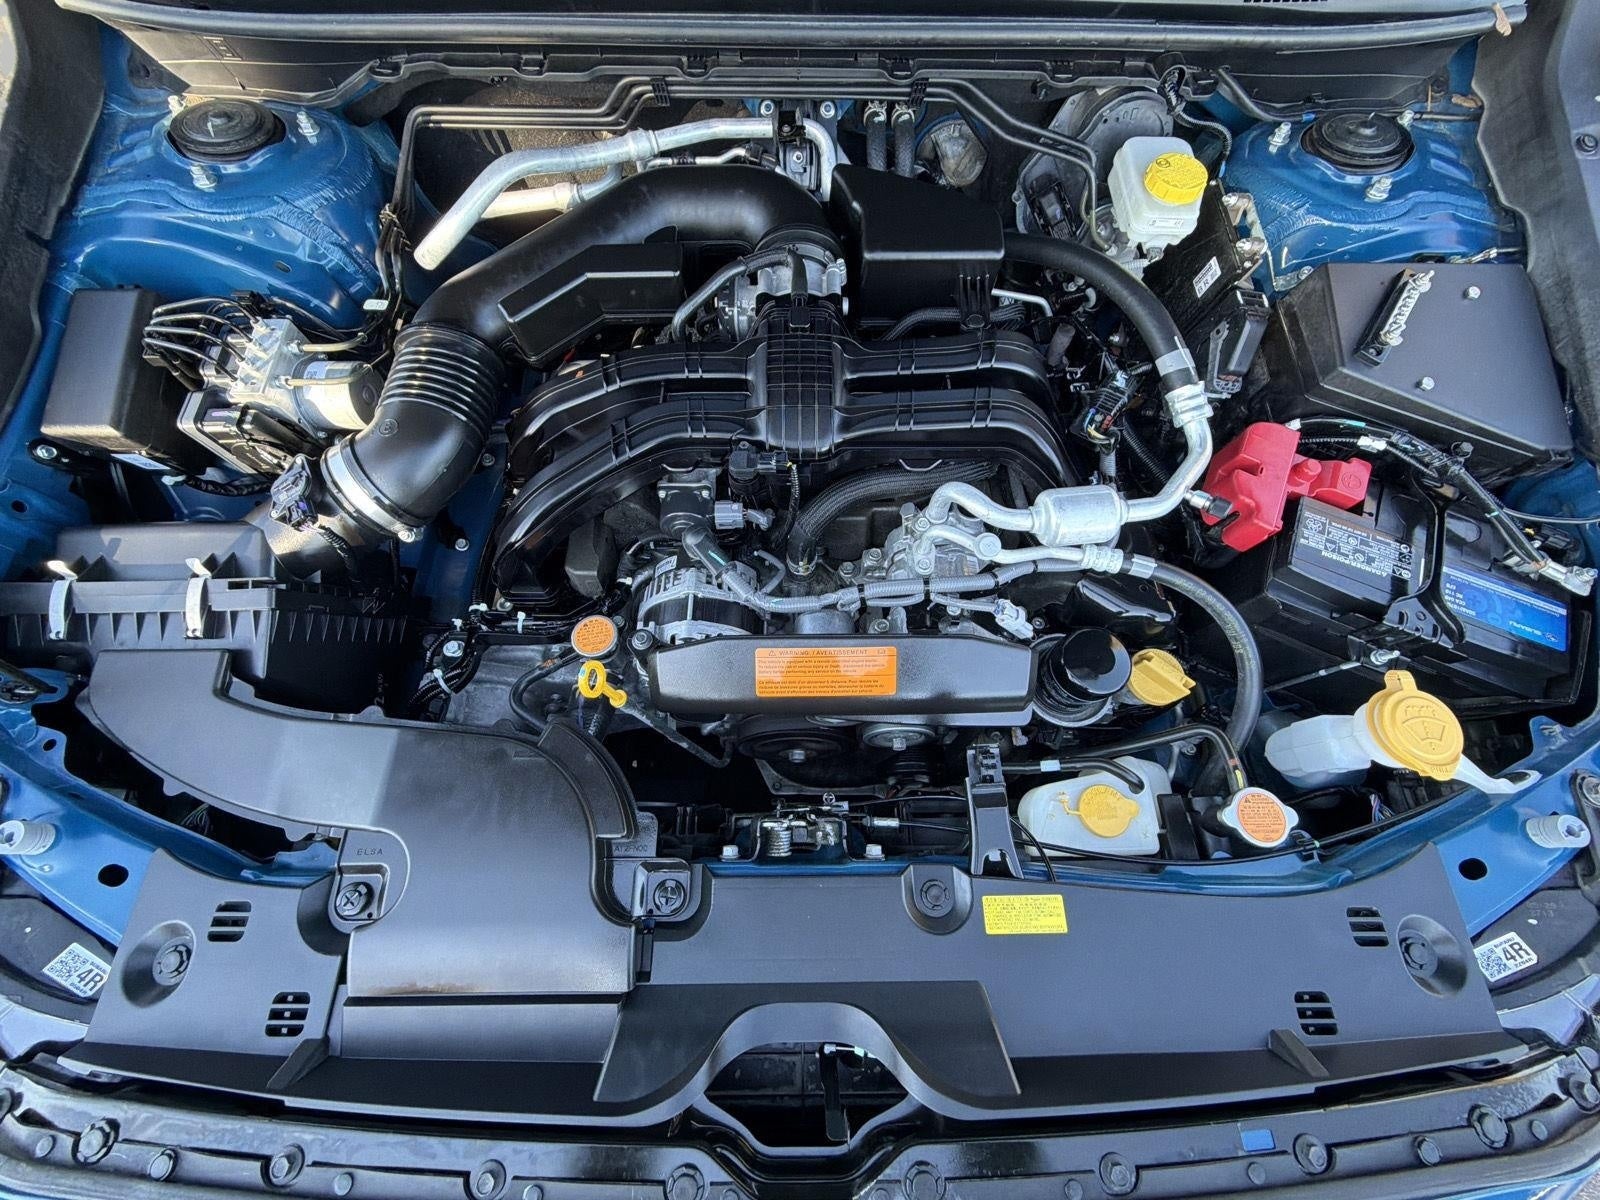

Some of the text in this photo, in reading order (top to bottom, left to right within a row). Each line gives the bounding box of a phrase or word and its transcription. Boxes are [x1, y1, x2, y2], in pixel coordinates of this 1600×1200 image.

[1509, 621, 1542, 636] SUBARU
[1502, 941, 1531, 962] 4R
[76, 968, 104, 992] 4R
